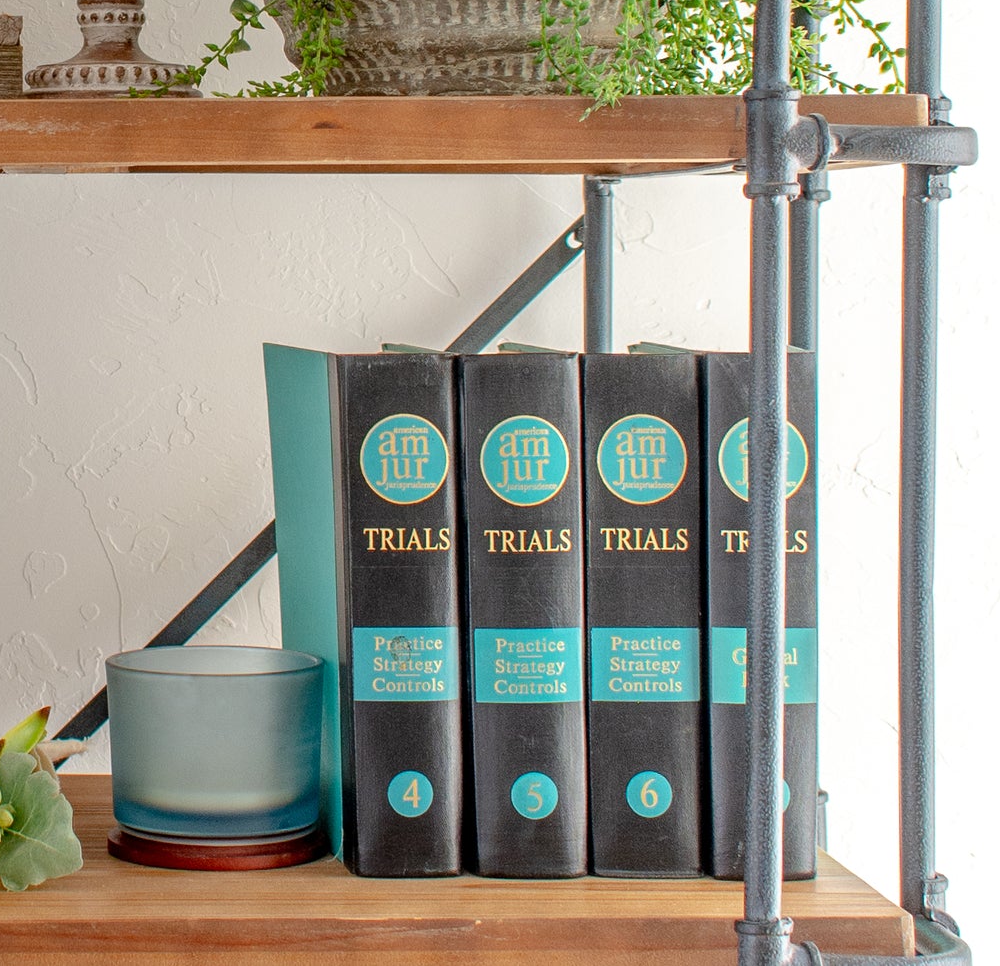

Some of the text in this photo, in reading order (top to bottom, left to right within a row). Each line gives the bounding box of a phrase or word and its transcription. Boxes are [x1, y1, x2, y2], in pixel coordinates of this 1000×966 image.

[393, 425, 429, 434] american
[378, 430, 430, 456] am
[499, 431, 551, 458] am
[615, 430, 667, 456] am
[376, 457, 430, 487] jur
[496, 458, 550, 488] jur
[612, 457, 667, 486] jur
[363, 527, 451, 552] TRIALS
[483, 529, 572, 553] TRIALS
[600, 527, 690, 552] TRIALS
[720, 529, 809, 554] TRLS
[373, 636, 444, 651] Practice
[495, 637, 566, 653] Practice
[610, 636, 681, 651] Practice
[373, 656, 443, 674] Strategy
[494, 658, 566, 676] Strategy
[609, 656, 681, 674] Strategy
[372, 677, 445, 693] Controls
[493, 679, 568, 695] Controls
[608, 677, 683, 693] Controls
[402, 778, 421, 809] 4
[526, 781, 544, 812] 5
[640, 778, 659, 809] 6
